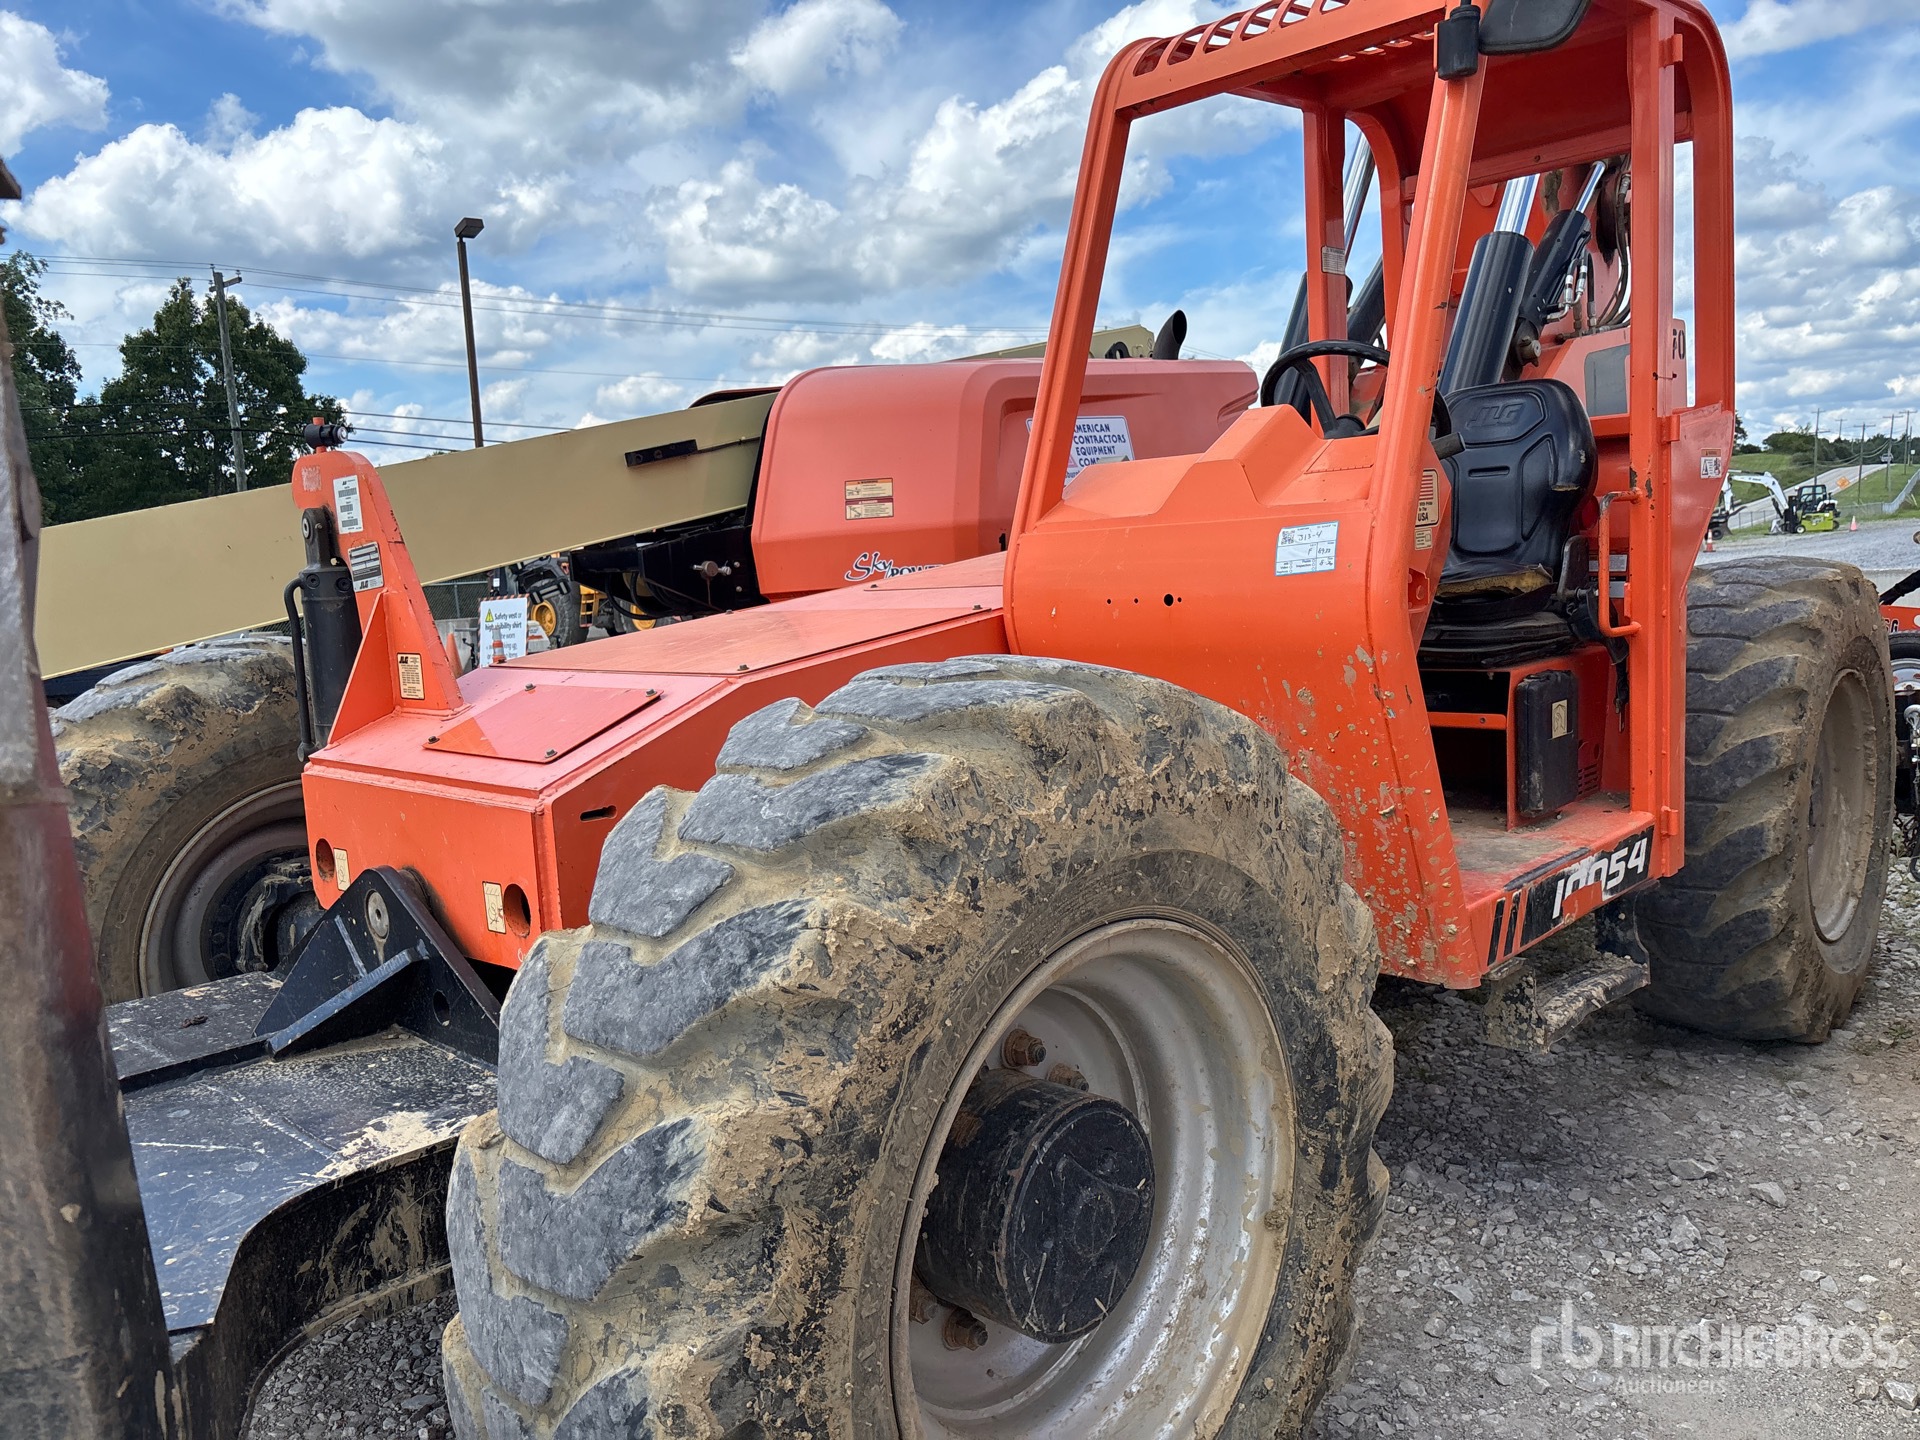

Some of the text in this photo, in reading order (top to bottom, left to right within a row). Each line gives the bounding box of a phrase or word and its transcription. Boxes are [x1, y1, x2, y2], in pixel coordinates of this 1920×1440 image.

[1466, 402, 1525, 428] JLG
[1073, 434, 1126, 445] CONTRACTORS
[1076, 445, 1116, 456] EQUIPMENT
[1078, 457, 1100, 467] COMP
[1417, 512, 1429, 522] USA
[844, 551, 894, 582] Sky
[494, 612, 508, 621] Safety
[512, 621, 522, 629] shirt
